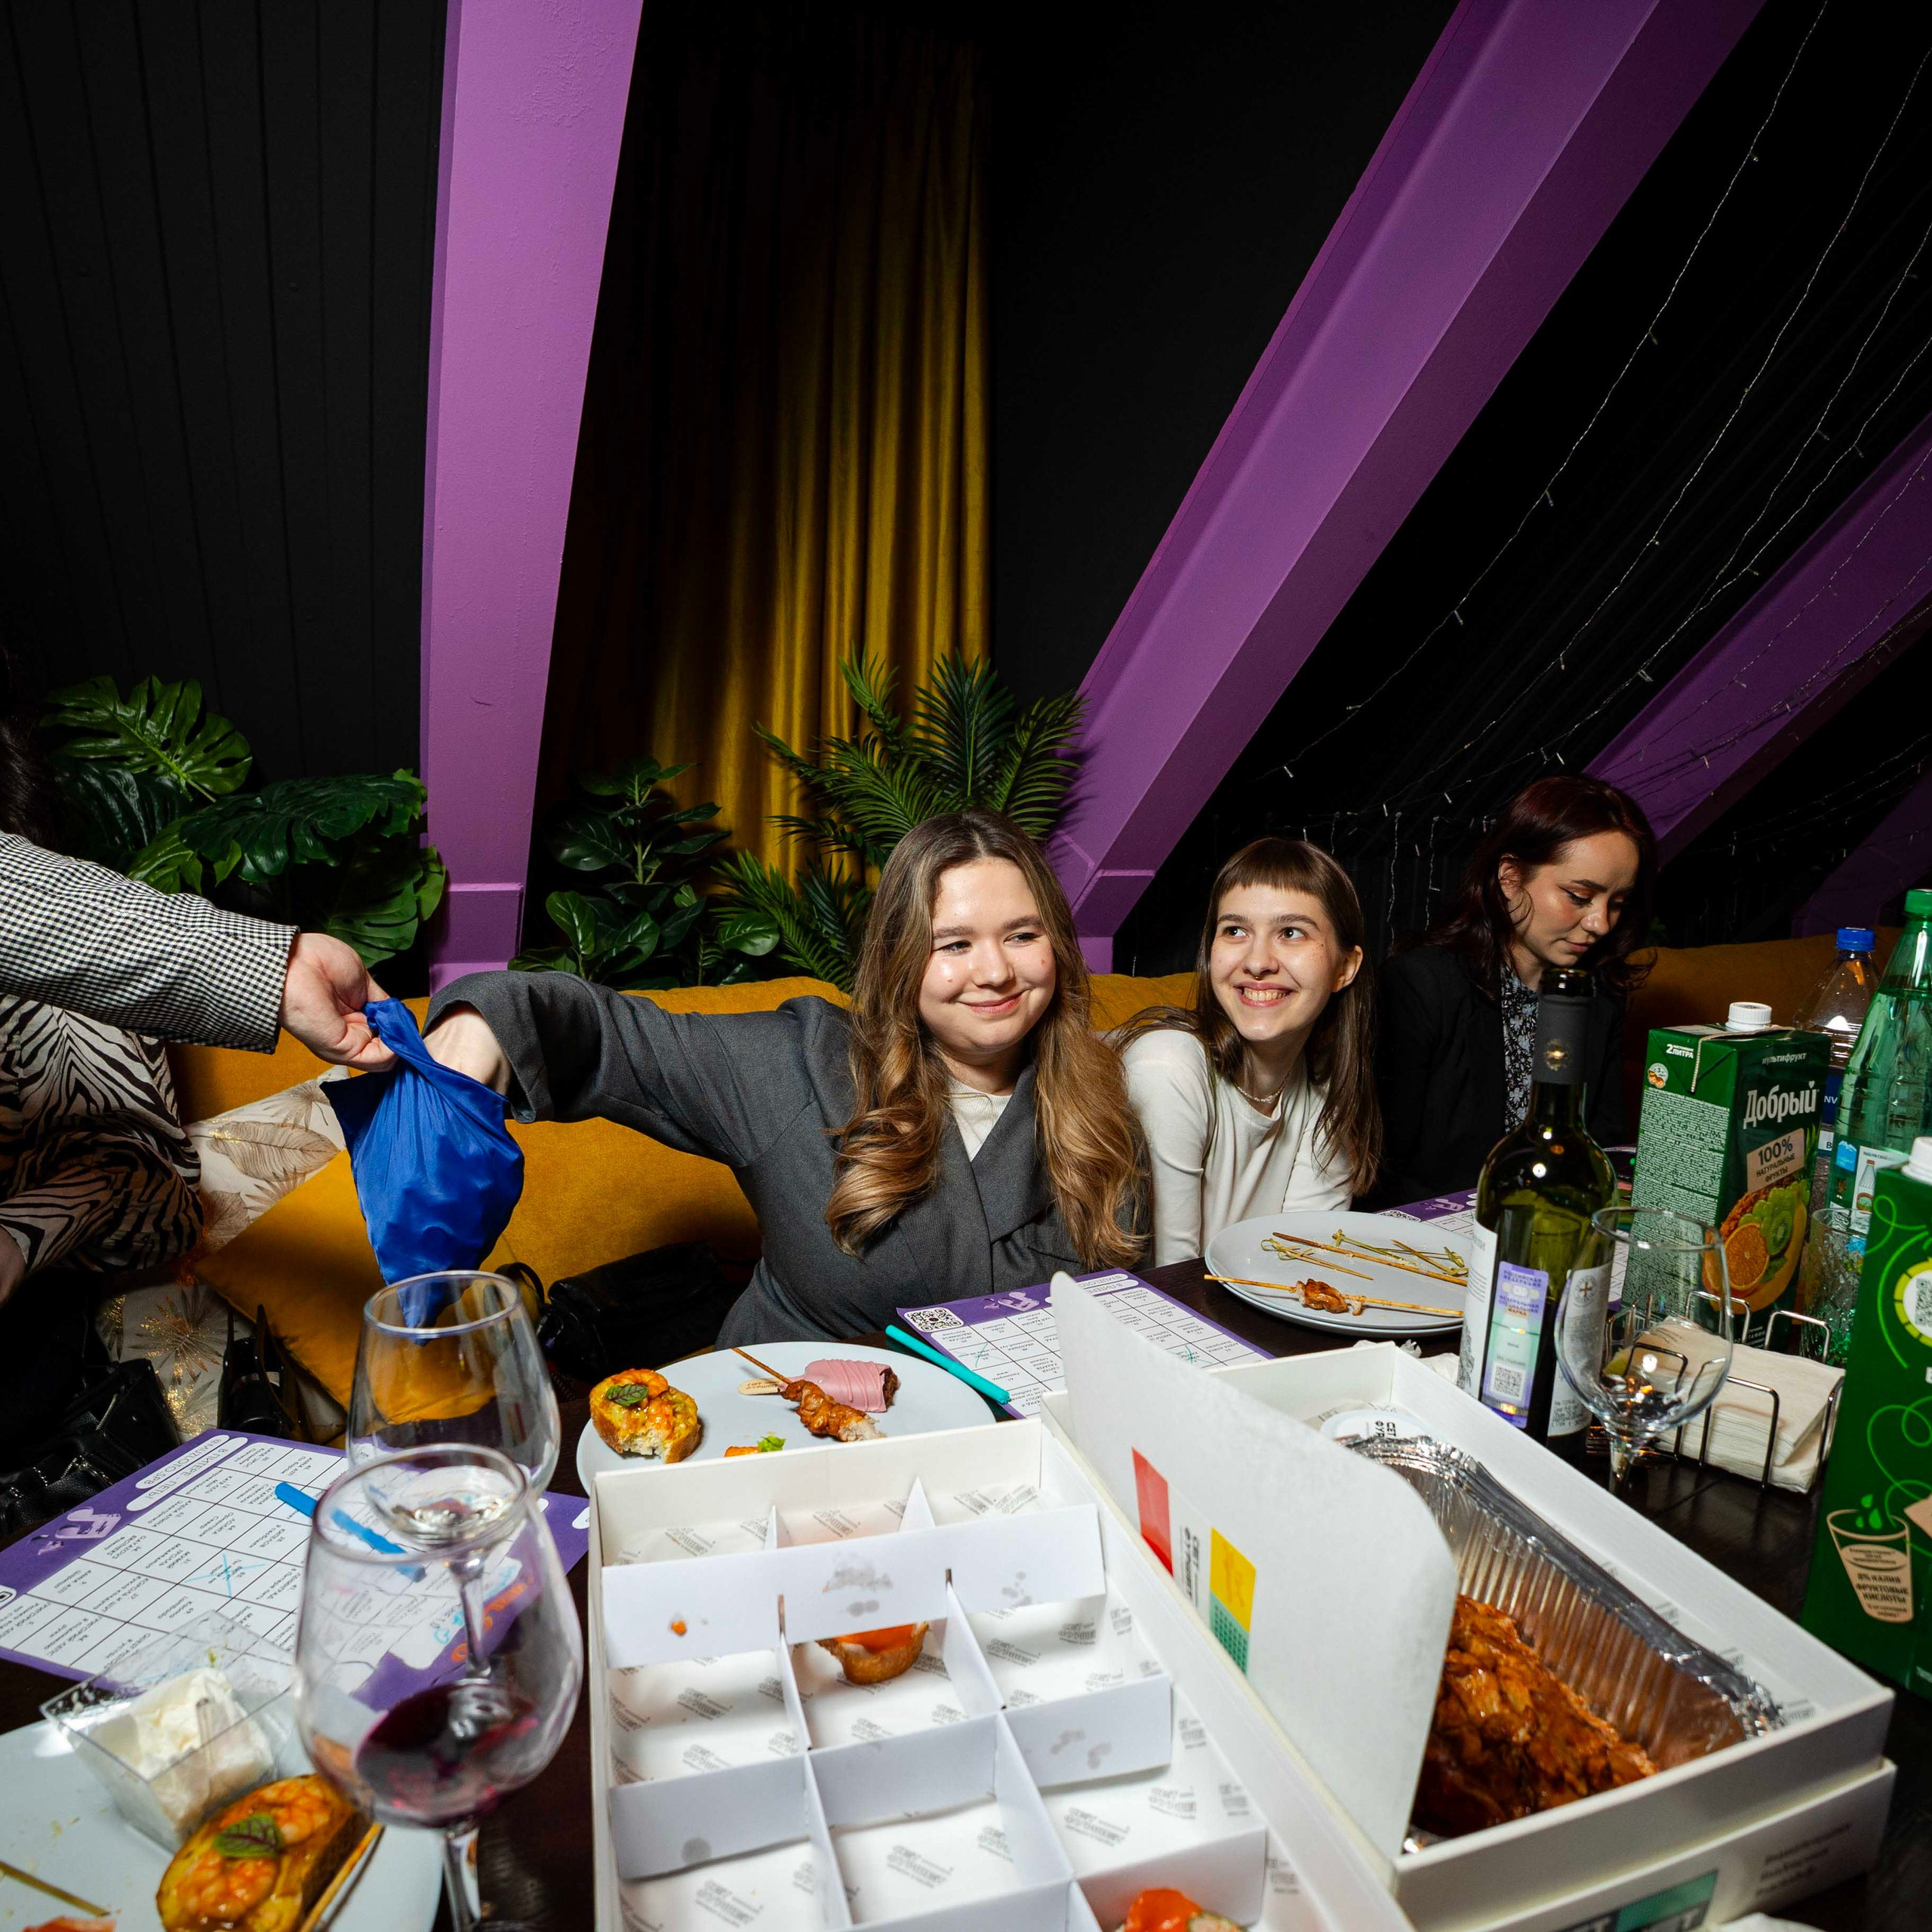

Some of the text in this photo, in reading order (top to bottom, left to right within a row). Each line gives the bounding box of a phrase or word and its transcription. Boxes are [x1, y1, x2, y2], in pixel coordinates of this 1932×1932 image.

[1672, 1048, 1694, 1059] ЛИТРА
[1761, 1053, 1807, 1065] мультифрукт
[1743, 1080, 1817, 1129] Добрый
[1758, 1136, 1793, 1166] 100%
[1756, 1154, 1795, 1177] НАТУРАЛЬНЫЕ
[1765, 1167, 1788, 1182] ФРУКТЫ
[178, 1452, 220, 1477] ПИТЕРЕ
[143, 1479, 179, 1500] ПЕТЬ!
